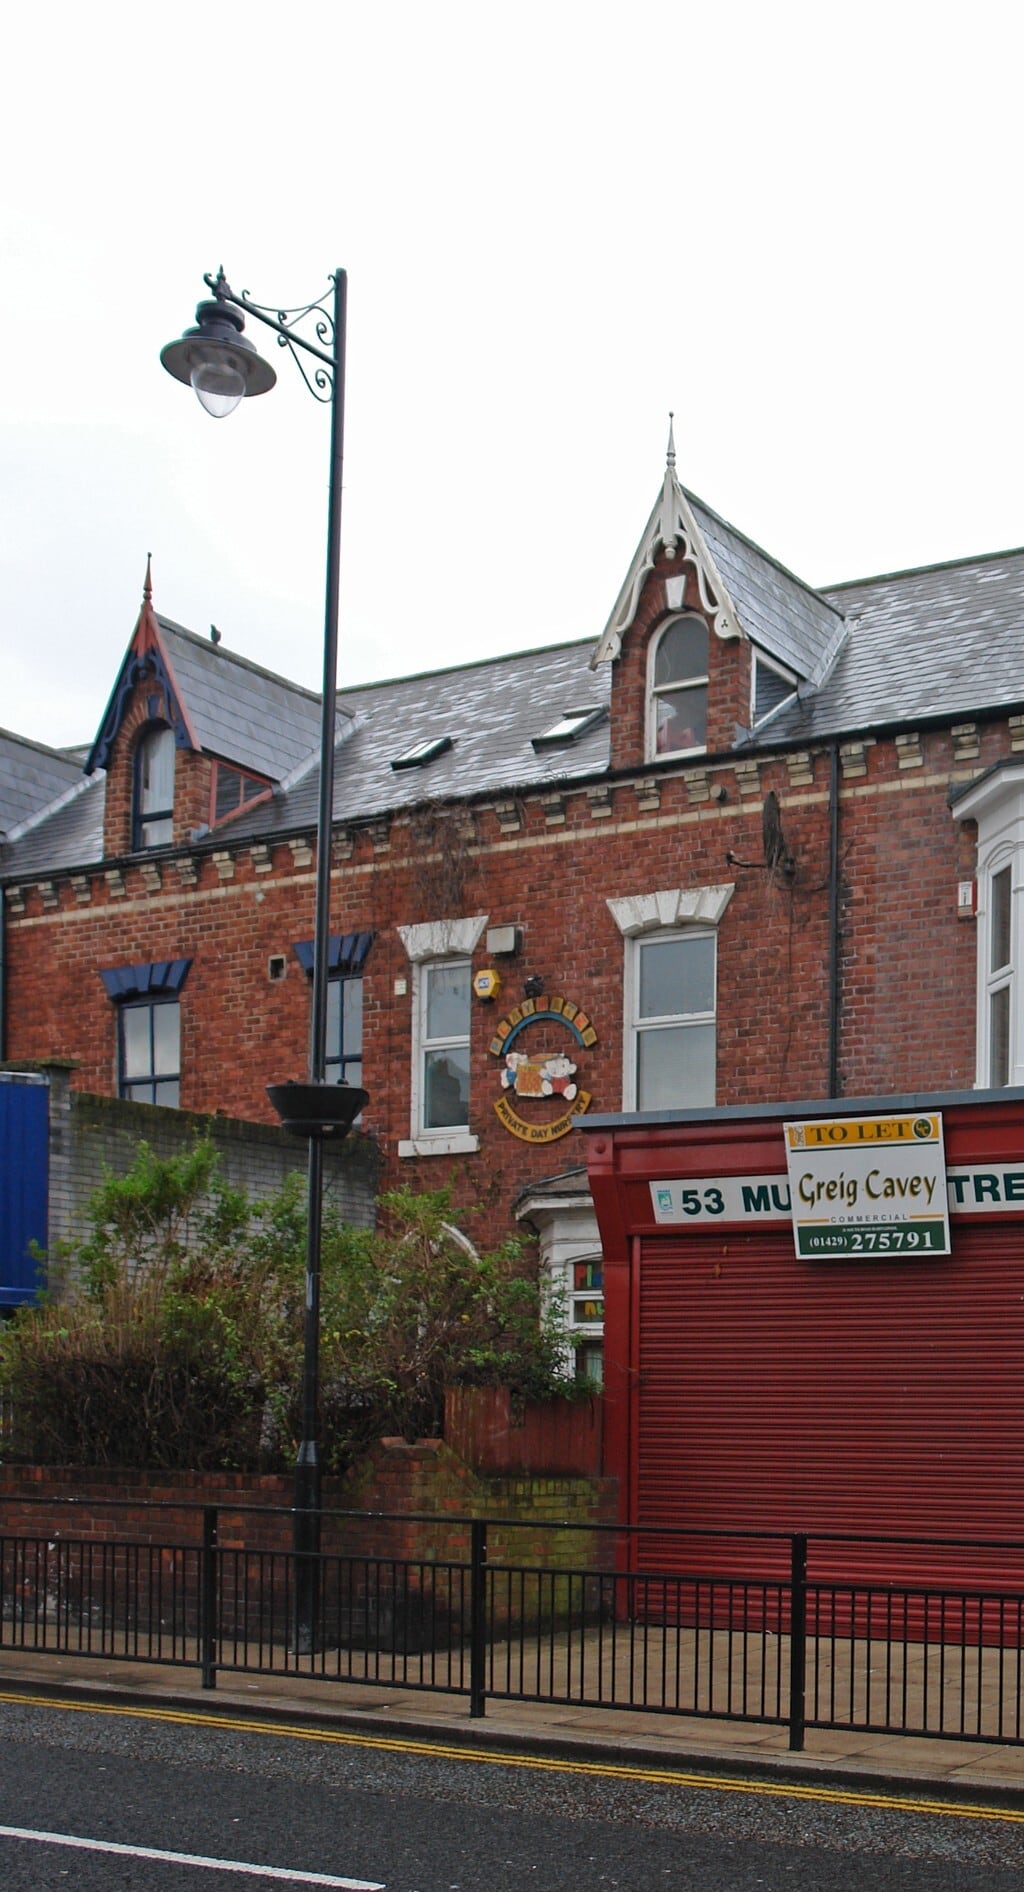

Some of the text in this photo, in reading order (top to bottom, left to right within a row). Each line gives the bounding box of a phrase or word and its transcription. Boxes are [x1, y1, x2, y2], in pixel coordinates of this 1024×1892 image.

[498, 1102, 529, 1136] PRIVATE
[531, 1127, 551, 1139] DAY
[810, 1125, 848, 1142] TO
[857, 1122, 909, 1140] LET
[799, 1169, 937, 1208] Greig Cavey
[682, 1188, 725, 1215] 53
[830, 1214, 909, 1223] COMMERCIAL
[809, 1231, 934, 1250] (01429) 275791
